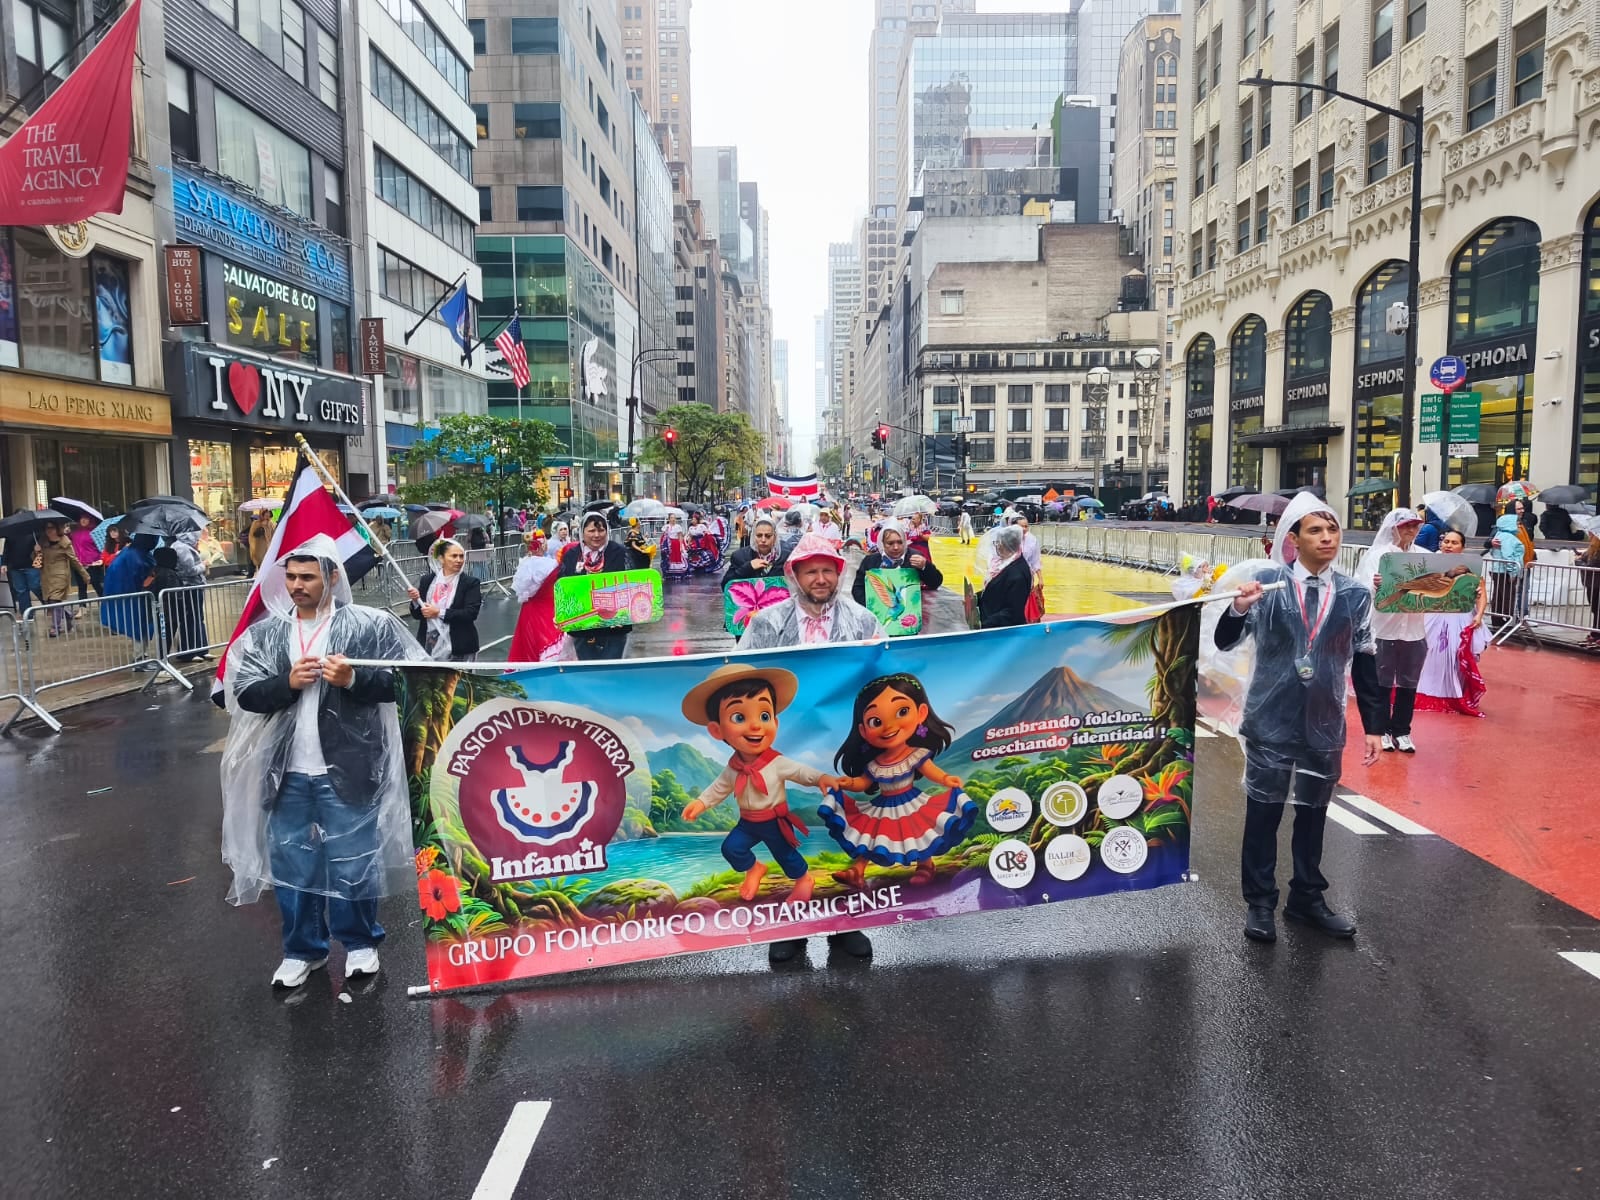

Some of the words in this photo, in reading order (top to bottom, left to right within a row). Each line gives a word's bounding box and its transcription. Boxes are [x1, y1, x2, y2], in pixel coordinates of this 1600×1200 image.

[25, 123, 56, 144] THE
[182, 215, 236, 249] DIAMONDS
[187, 178, 293, 253] SALVATORE
[300, 239, 312, 264] &
[172, 258, 193, 267] BUY
[174, 250, 191, 258] WE
[174, 282, 183, 308] GOLD
[223, 263, 290, 303] SALVATORE
[291, 289, 299, 306] &
[301, 292, 316, 312] CO
[228, 296, 311, 352] SALE
[368, 320, 380, 371] DIAMONDS
[1464, 343, 1528, 371] EPHORA
[209, 357, 228, 410] I
[320, 399, 359, 425] GIFTS
[1287, 382, 1328, 401] SEPHORA
[1357, 367, 1405, 389] SEPHOR
[28, 391, 59, 411] LAO
[65, 395, 106, 417] FENG
[111, 401, 153, 421] XIANG
[1231, 395, 1265, 412] SEPHORA
[451, 712, 515, 776] PASION
[516, 709, 545, 727] DE
[551, 716, 579, 729] MI
[583, 723, 632, 778] TIERRA
[972, 735, 1069, 759] cosechando
[1072, 727, 1155, 745] identidad
[986, 715, 1081, 741] Sembrando
[491, 838, 606, 881] Infantil
[448, 934, 536, 966] GRUPO
[545, 913, 705, 953] FOLCLORICO
[714, 885, 903, 930] COSTARRICENSE
